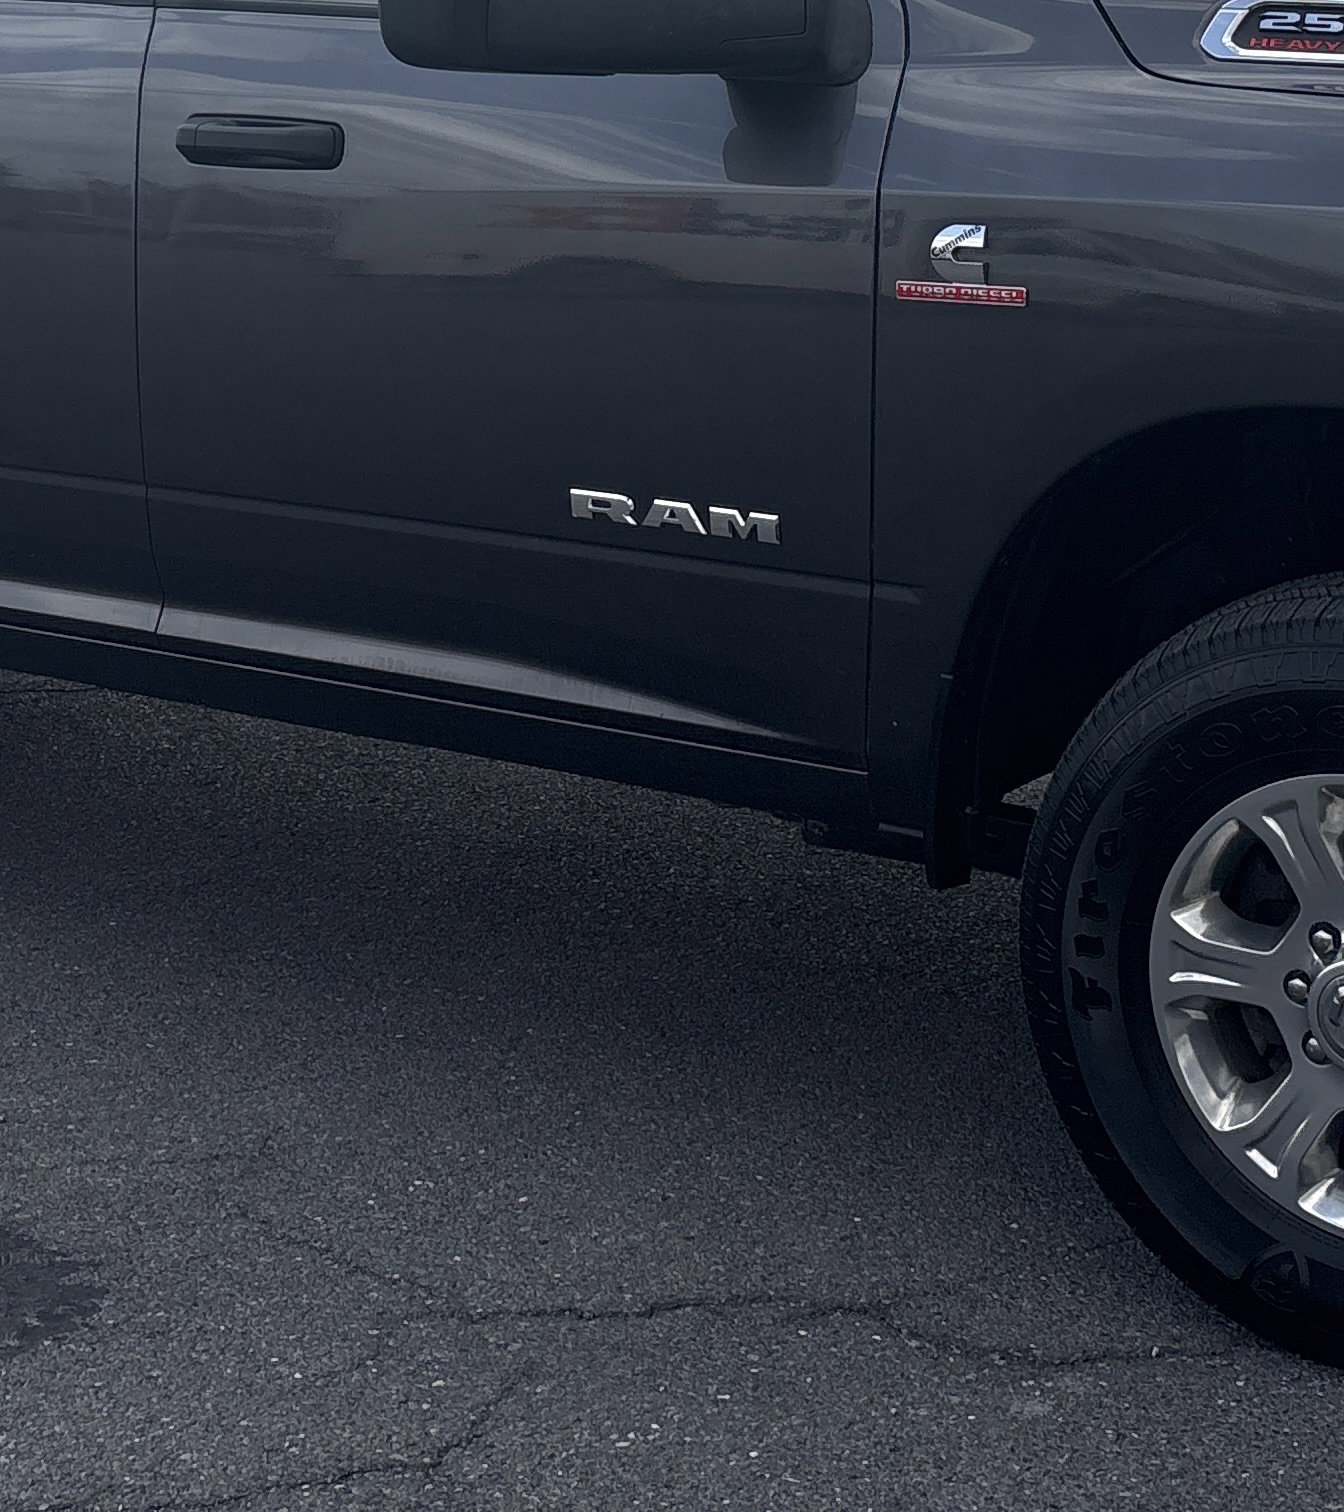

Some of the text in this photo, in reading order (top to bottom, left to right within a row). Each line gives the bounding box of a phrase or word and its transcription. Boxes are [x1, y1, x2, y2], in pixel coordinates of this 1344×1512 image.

[1249, 37, 1342, 52] HEAVY
[931, 224, 982, 258] Cummins
[899, 284, 1024, 303] TURBO DIESEL
[569, 488, 780, 545] RAM
